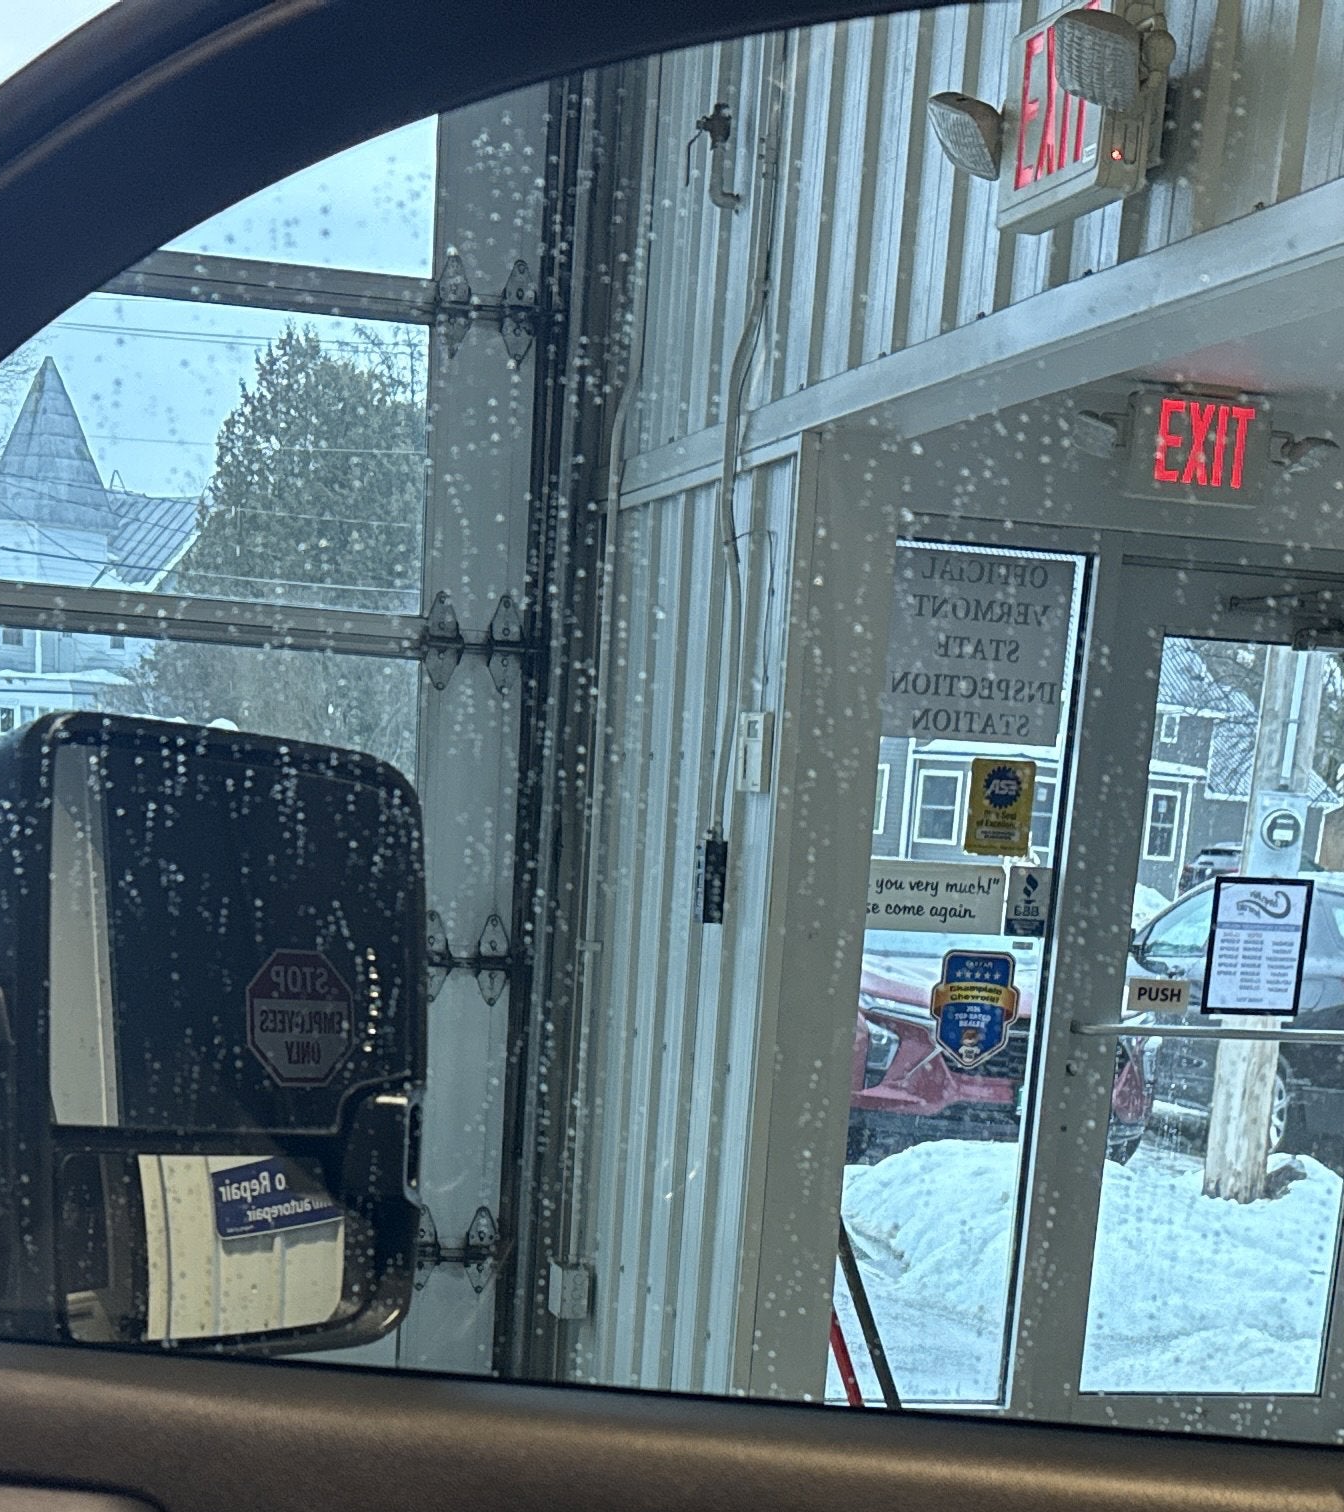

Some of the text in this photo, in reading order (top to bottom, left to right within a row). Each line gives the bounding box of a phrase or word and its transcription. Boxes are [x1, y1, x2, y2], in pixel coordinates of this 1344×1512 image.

[1155, 399, 1256, 489] EXIT
[985, 779, 1017, 795] ASE
[875, 878, 905, 895] you
[909, 879, 939, 897] very
[885, 904, 925, 917] come
[1137, 986, 1182, 1002] PUSH
